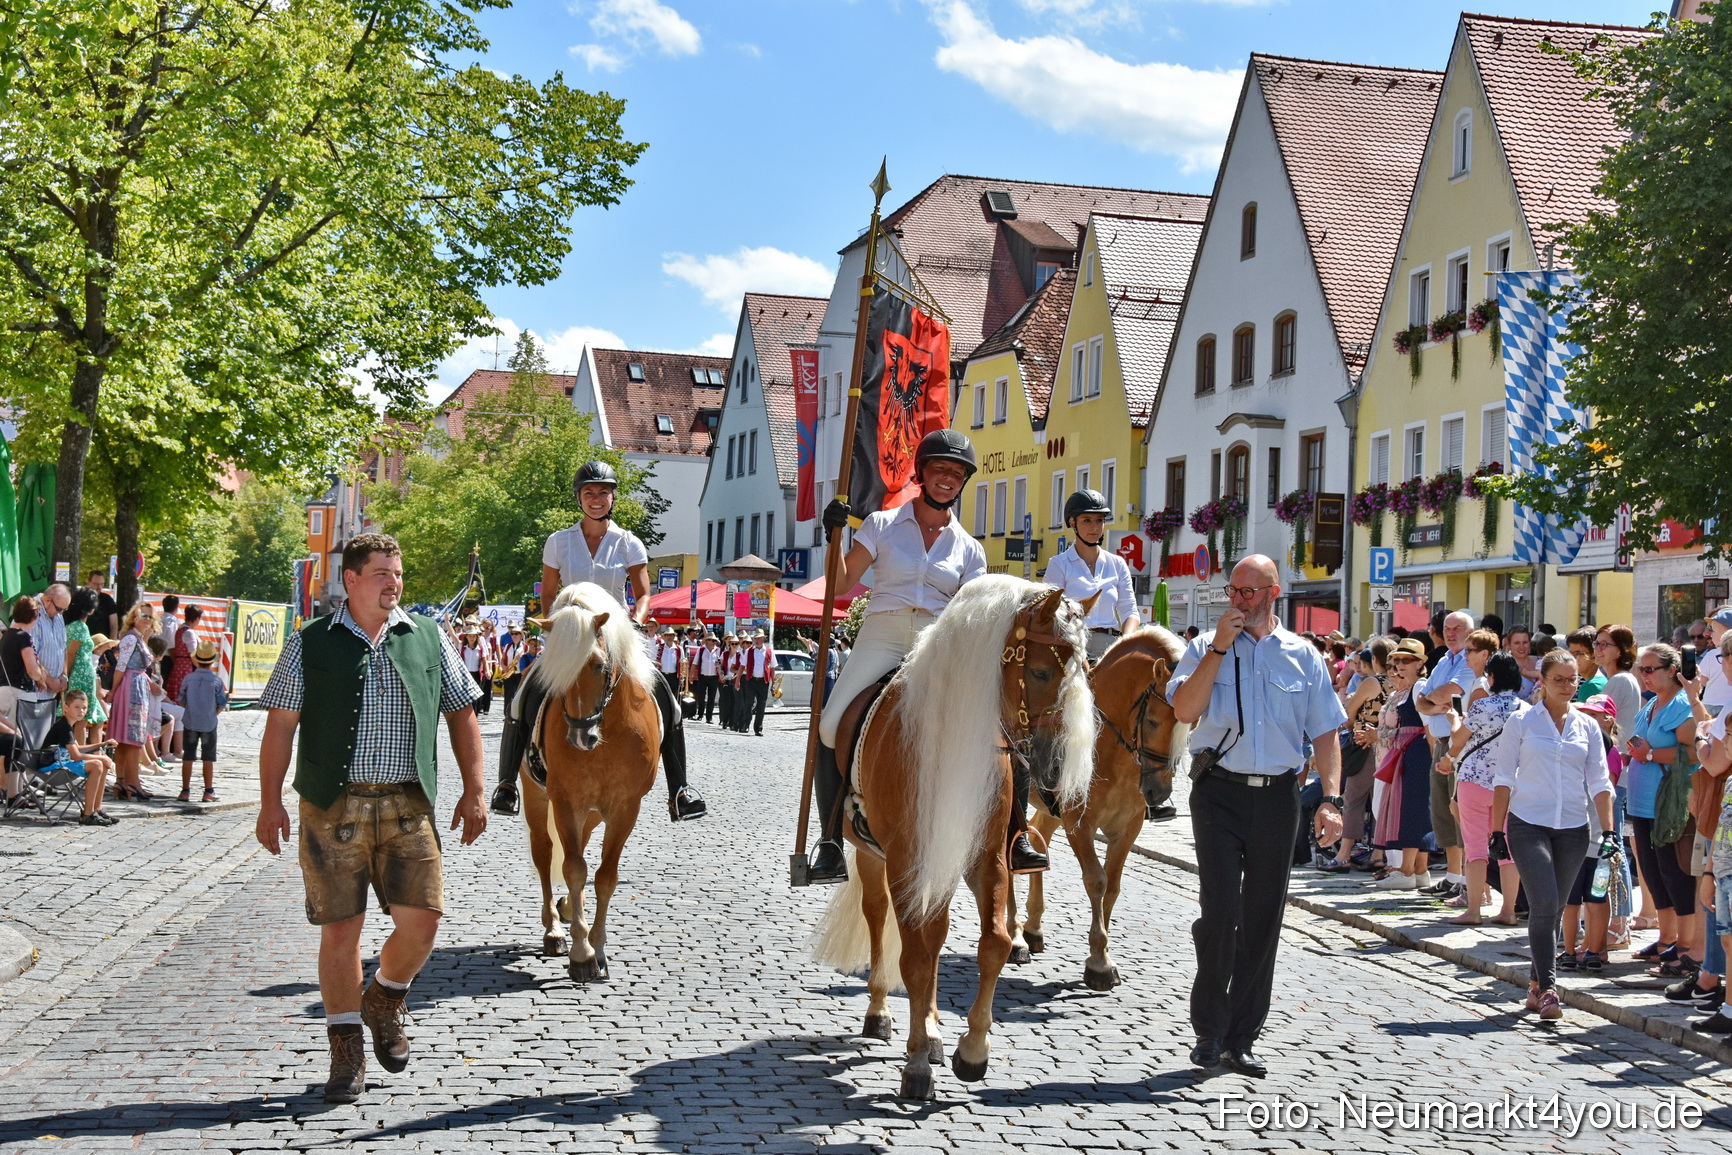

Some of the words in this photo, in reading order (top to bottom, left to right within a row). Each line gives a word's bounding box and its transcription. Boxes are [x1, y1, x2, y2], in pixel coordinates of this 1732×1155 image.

[982, 452, 1006, 474] HOTEL
[1012, 448, 1039, 467] Lehmeier
[1375, 552, 1388, 580] P
